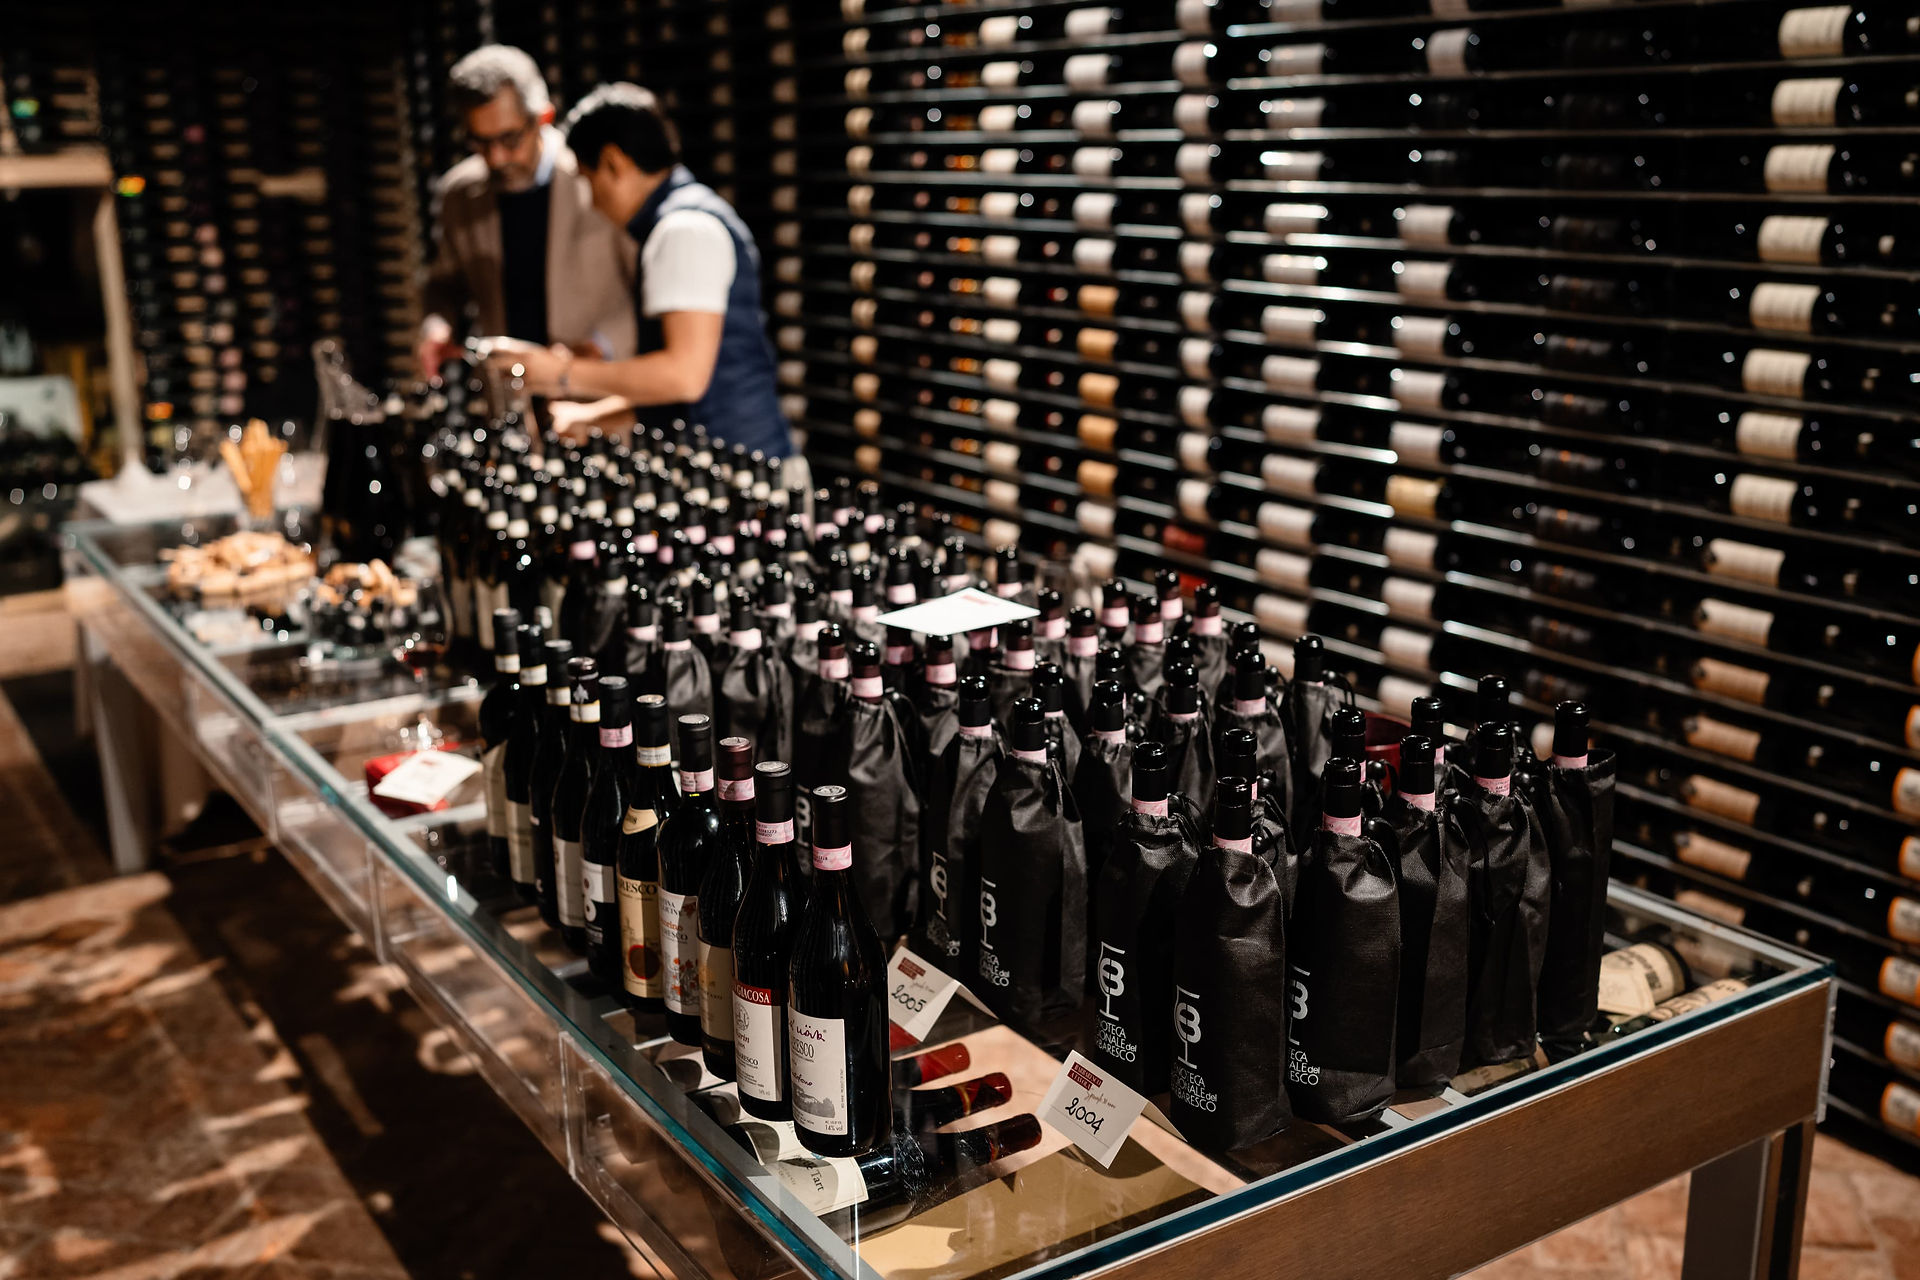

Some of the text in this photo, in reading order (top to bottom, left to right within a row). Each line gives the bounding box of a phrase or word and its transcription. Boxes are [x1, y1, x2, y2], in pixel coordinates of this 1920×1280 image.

[891, 984, 927, 1013] 2005
[1125, 1043, 1138, 1053] del
[1307, 1065, 1321, 1075] del
[1205, 1092, 1218, 1102] del
[1065, 1097, 1105, 1135] 2004
[810, 1168, 825, 1192] Tart
